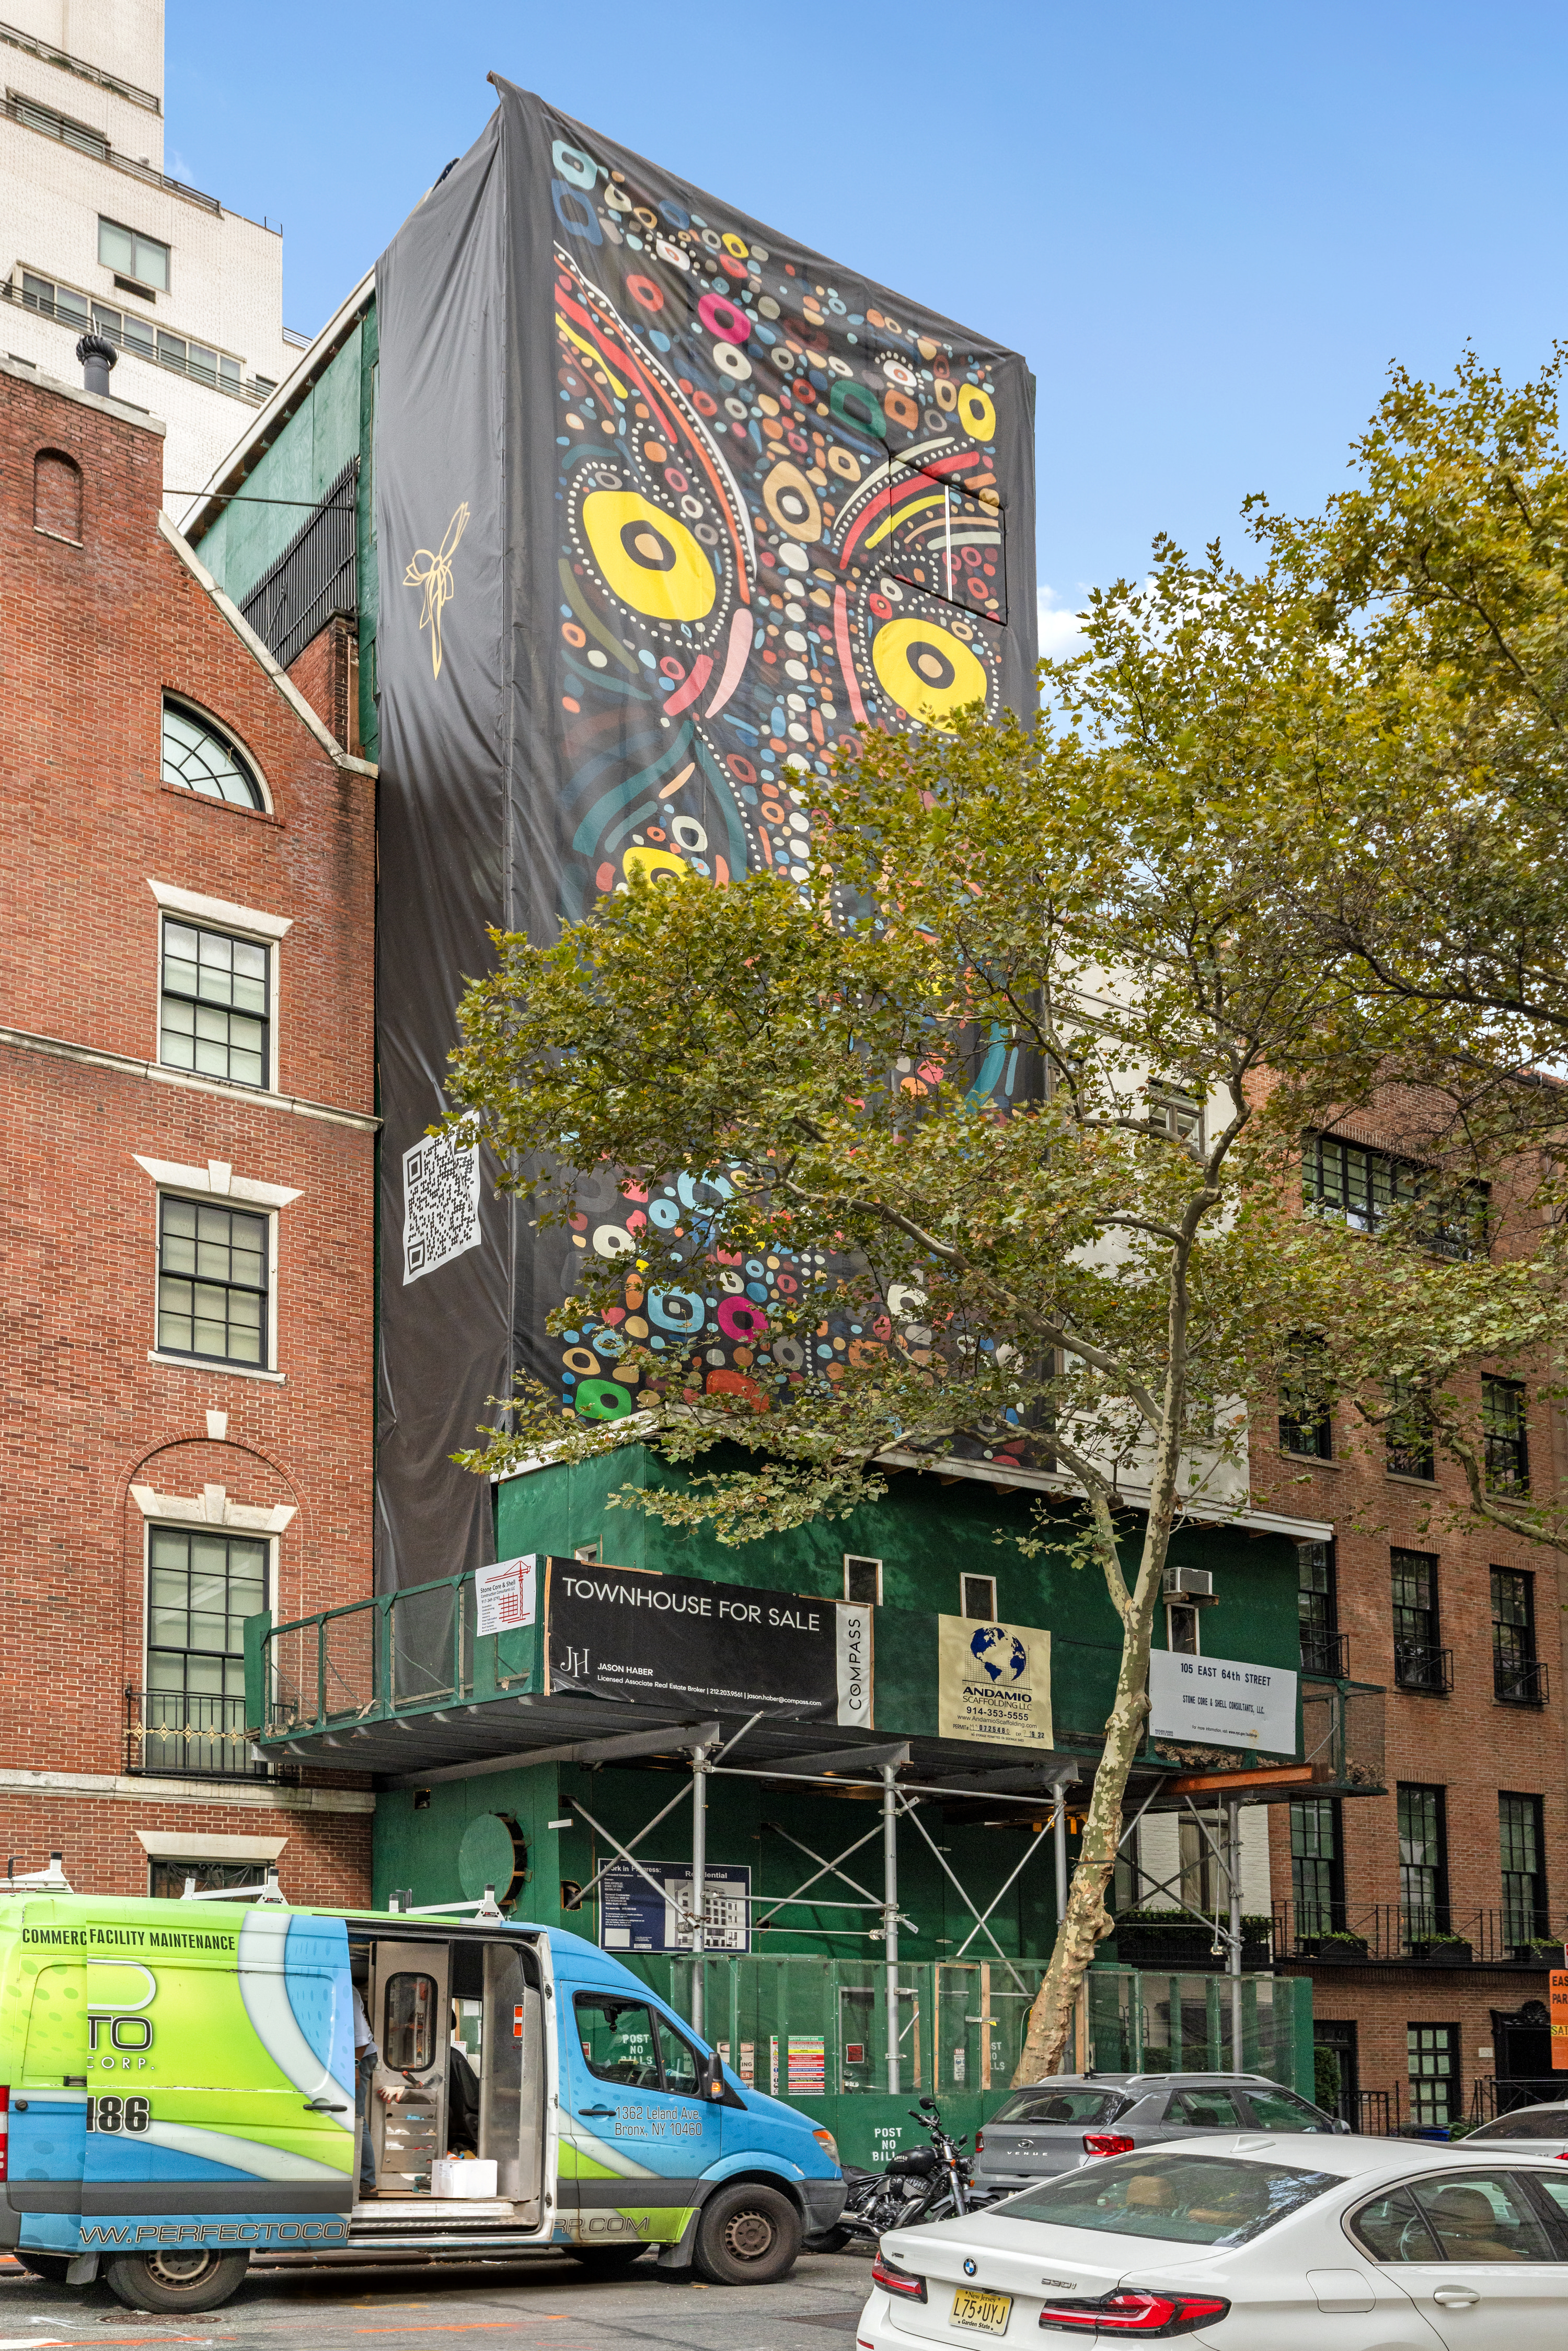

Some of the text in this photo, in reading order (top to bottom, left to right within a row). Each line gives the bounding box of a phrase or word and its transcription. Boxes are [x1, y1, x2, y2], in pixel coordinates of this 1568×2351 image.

[562, 1577, 820, 1631] TOWNHOUSE FOR SALE
[597, 1663, 653, 1676] JASON HABER
[848, 1618, 862, 1710] COMPASS
[1181, 1663, 1271, 1686] 105 EAST 64th STREET
[597, 1675, 623, 1684] Licensed
[625, 1678, 653, 1687] Associate
[710, 1688, 743, 1698] 212.203.9561
[747, 1692, 822, 1706] jason.haber@compass.com
[963, 1686, 1032, 1702] ANDAMIO
[963, 1696, 1018, 1709] SCAFFOLDING
[1183, 1695, 1195, 1704] STONE
[1197, 1697, 1208, 1705] CORE
[1215, 1700, 1227, 1708] SHELL
[1229, 1701, 1254, 1713] CONSULTANTS,
[1256, 1705, 1265, 1714] LLC.
[966, 1706, 1029, 1721] 914-353-5555
[958, 1715, 1037, 1728] www.AndamioScaffolding.com
[22, 1928, 236, 1950] COMMERC FACILITY MAINTENANCE
[1552, 1976, 1568, 1986] EAS
[1552, 1993, 1568, 2004] PAR
[622, 2034, 649, 2044] POST
[630, 2045, 643, 2054] NO
[991, 2042, 1002, 2050] ST
[615, 2106, 702, 2120] 1362 Leland Ave.
[615, 2123, 702, 2137] Bronx, NY 10460
[874, 2127, 902, 2138] POST
[882, 2139, 896, 2150] NO
[980, 2294, 997, 2303] Jersey
[953, 2297, 1006, 2324] L75 UYJ
